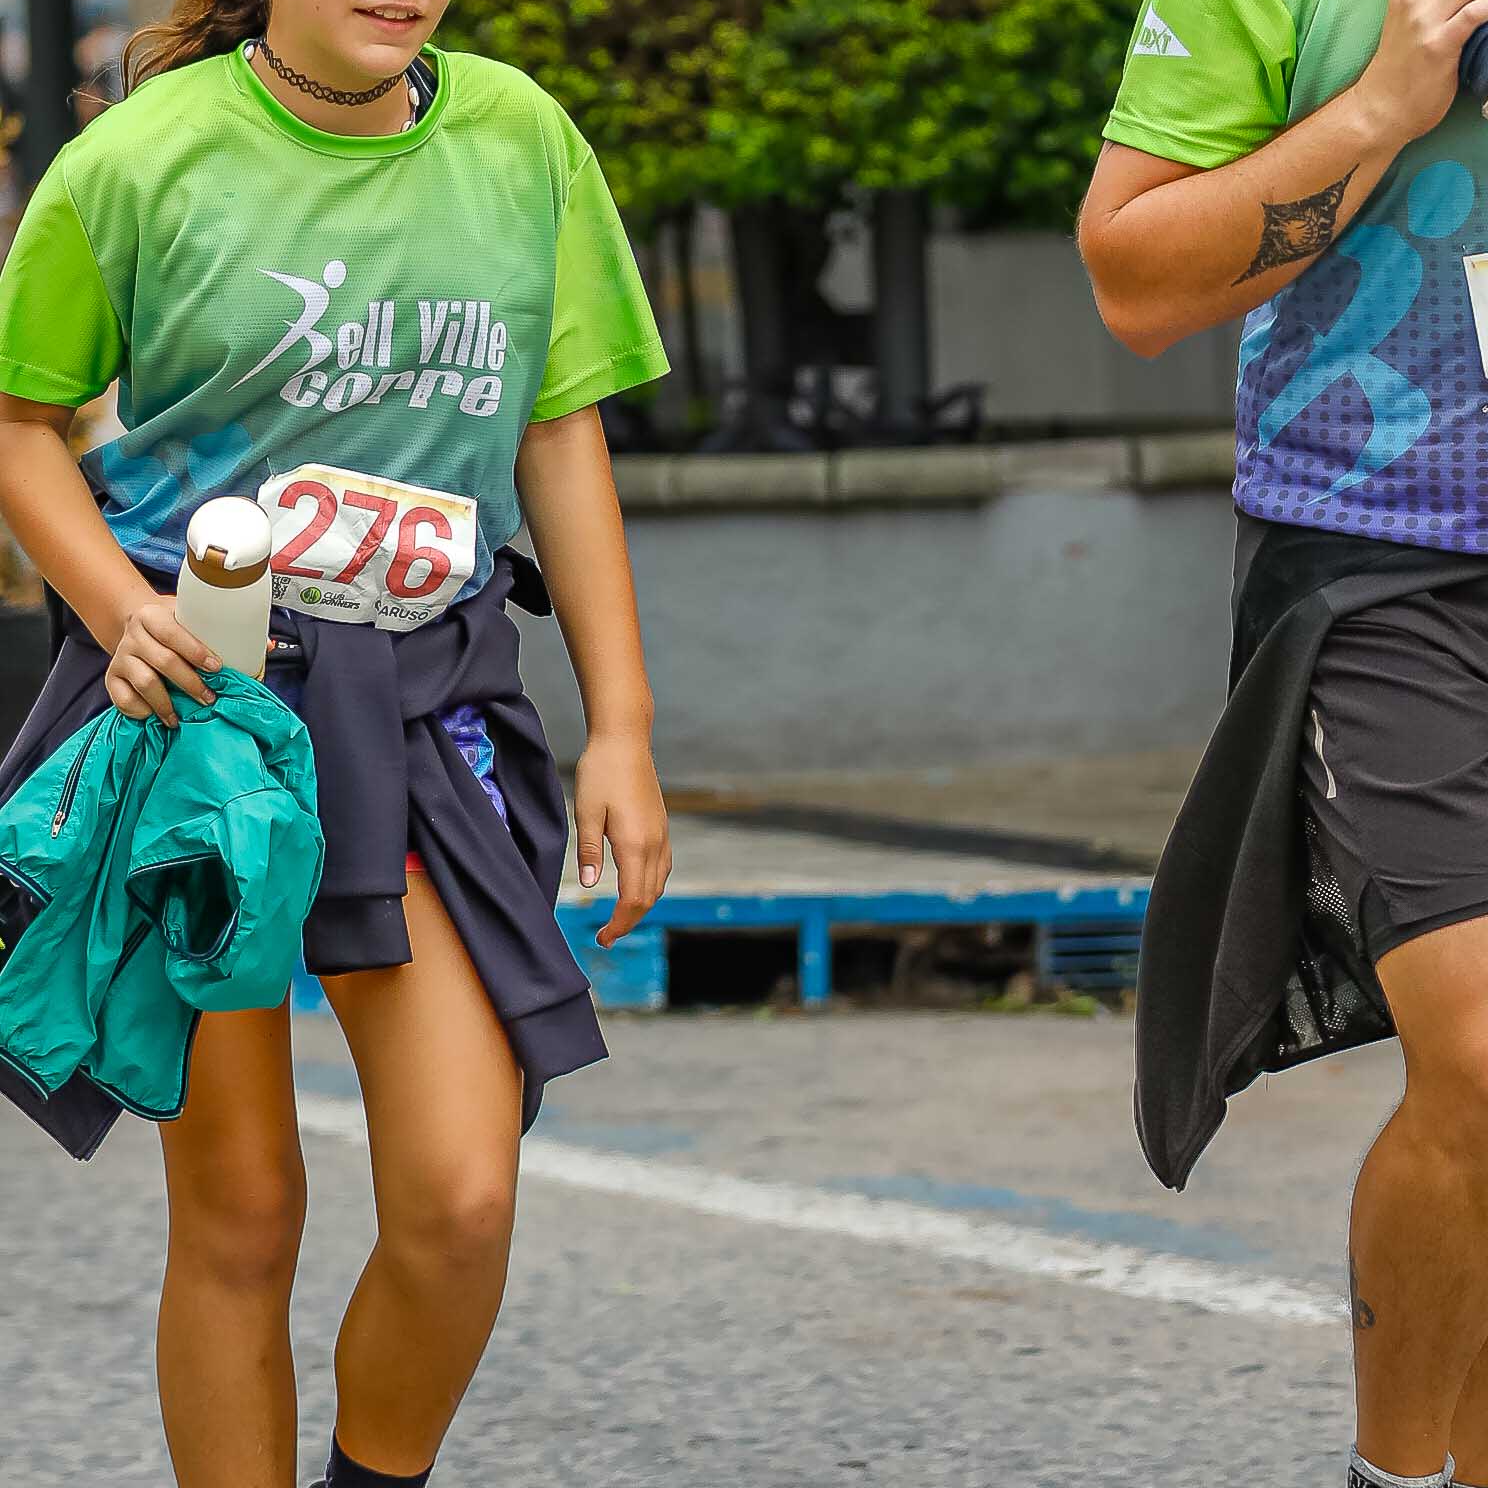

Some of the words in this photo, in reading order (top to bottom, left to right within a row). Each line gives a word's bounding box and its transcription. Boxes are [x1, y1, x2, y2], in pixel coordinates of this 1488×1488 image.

[417, 300, 508, 371] Ville
[279, 369, 504, 417] corre
[269, 479, 453, 599] 276
[322, 591, 346, 601] CLUB
